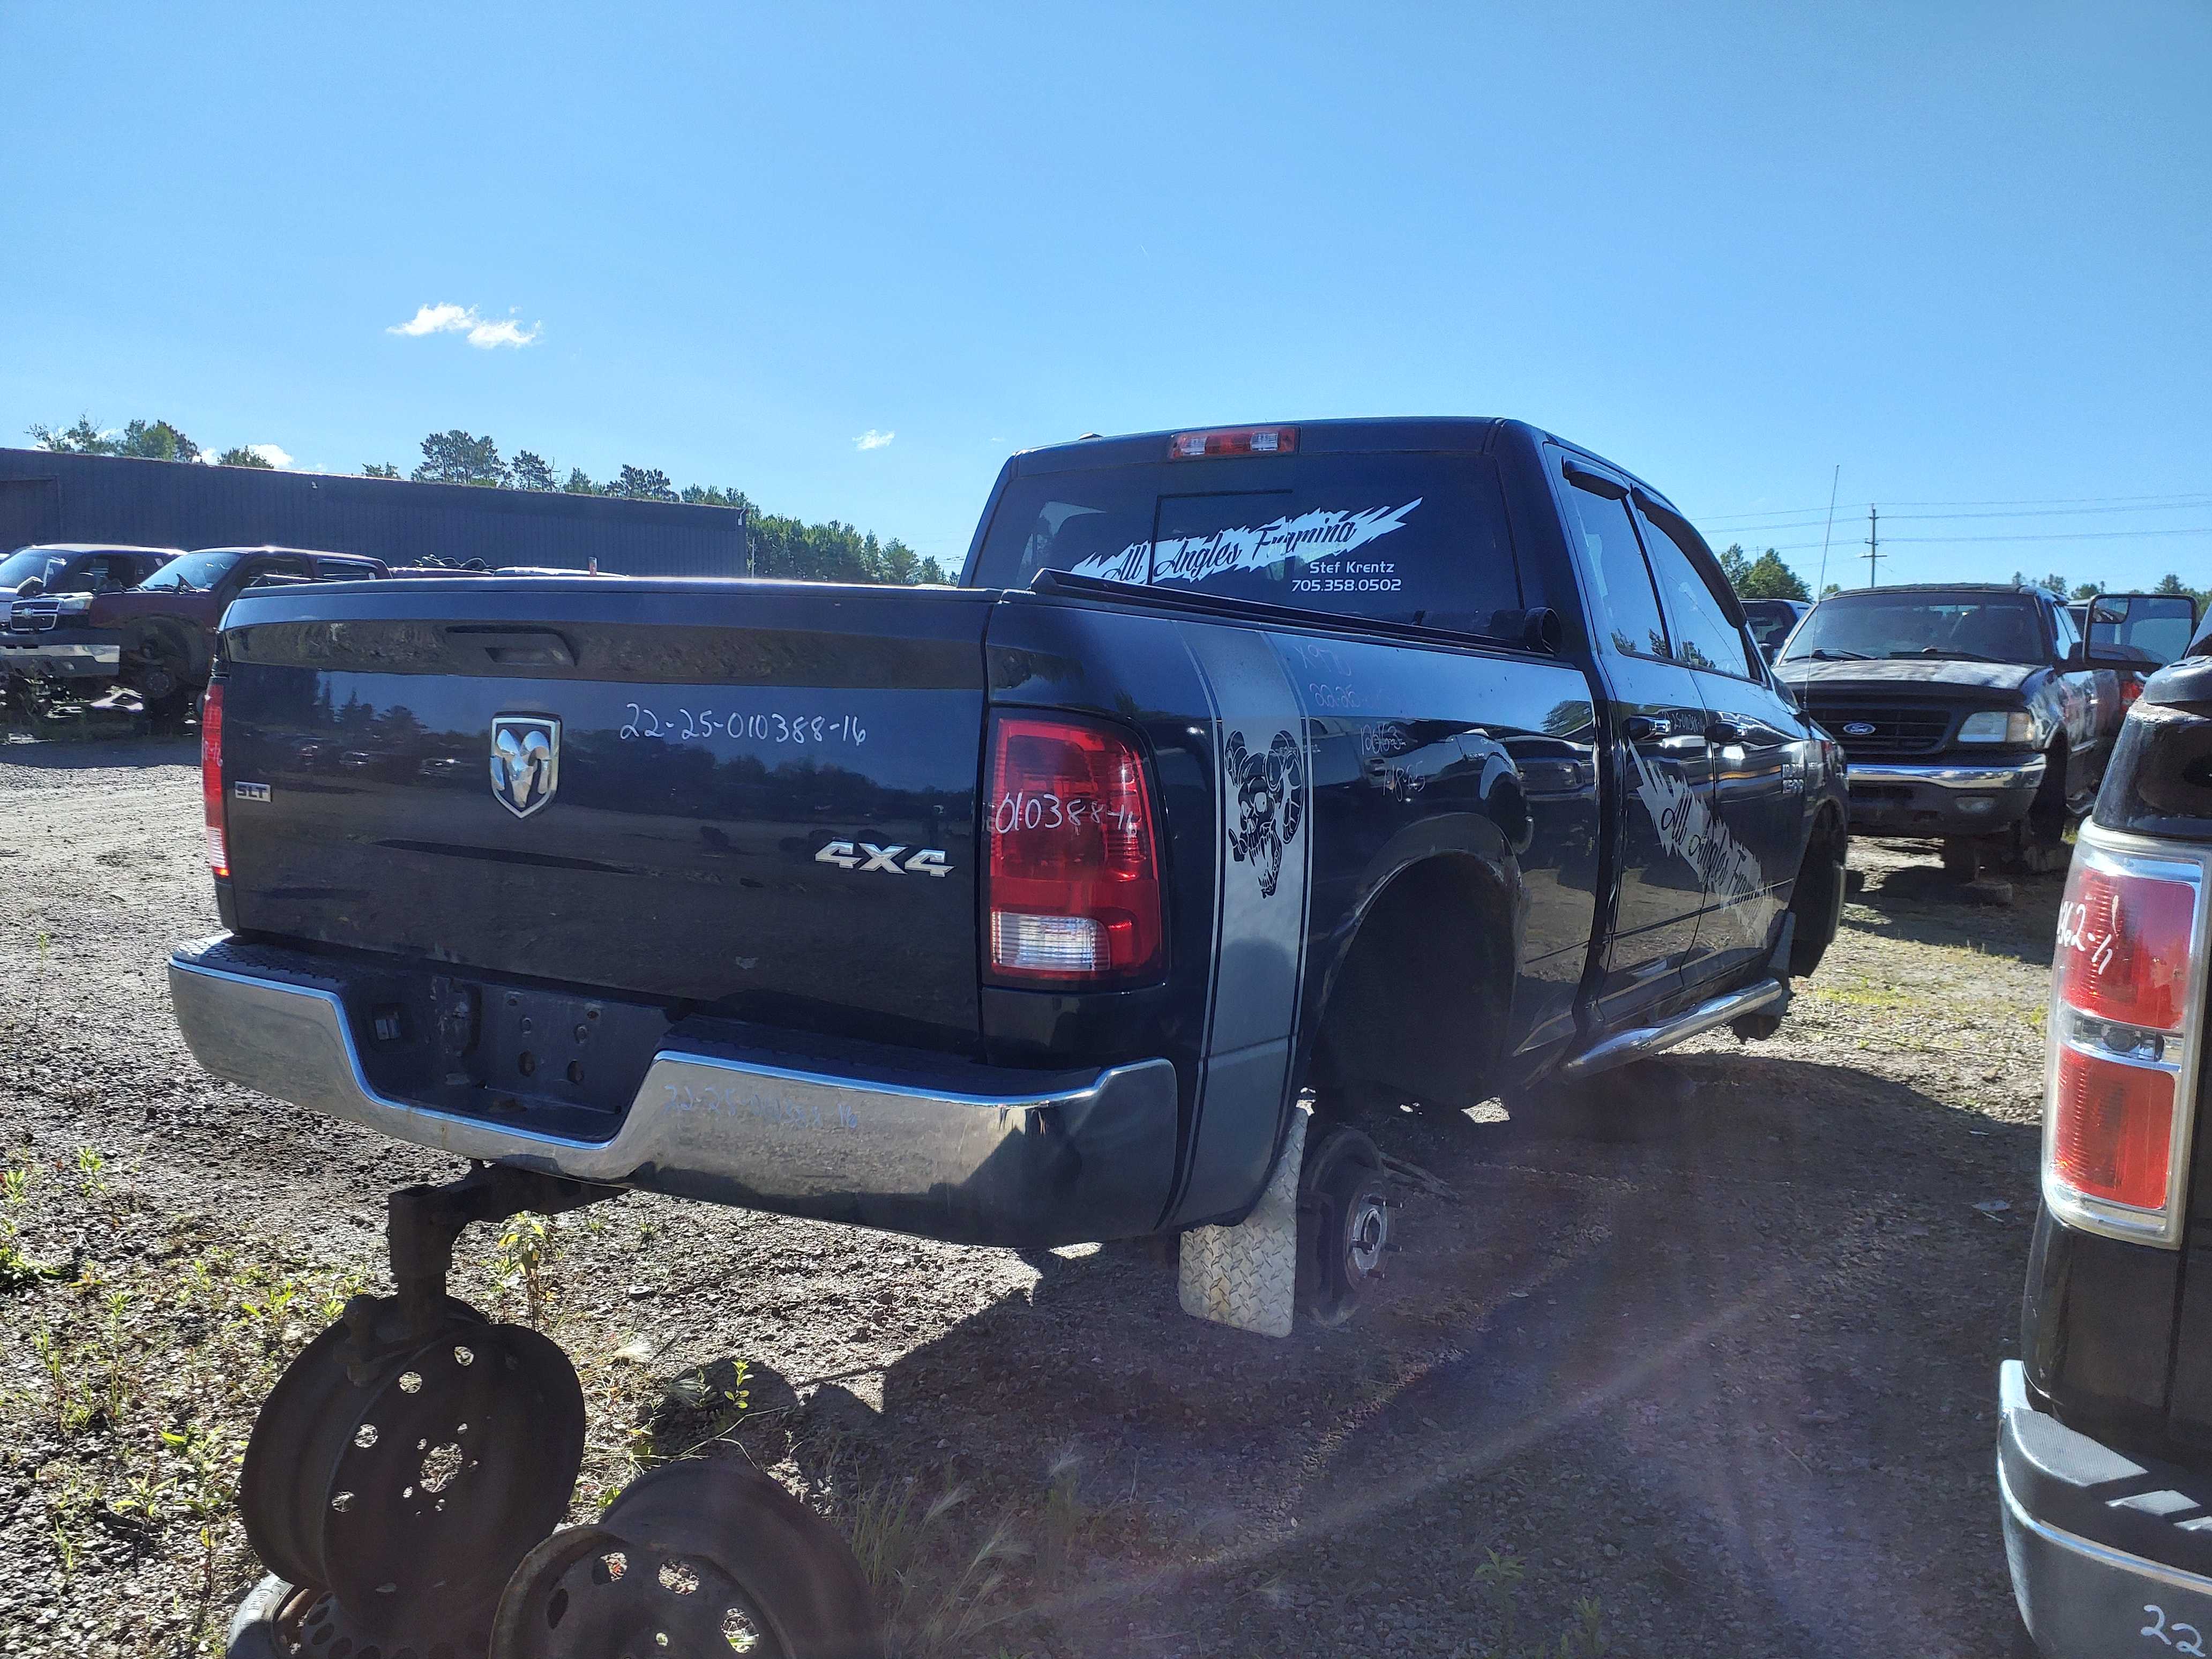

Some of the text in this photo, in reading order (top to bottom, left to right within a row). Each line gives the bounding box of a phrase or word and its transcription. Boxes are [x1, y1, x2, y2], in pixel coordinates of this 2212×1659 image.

[1101, 543, 1147, 580] All
[1153, 533, 1243, 578] Angles
[1310, 561, 1395, 574] Stef Krentz
[1291, 579, 1401, 592] 705.358.0502
[619, 703, 866, 746] 22-25-010388-16
[236, 784, 267, 799] SLT
[995, 792, 1138, 837] 010388-16
[1662, 794, 1692, 846] All
[2141, 1605, 2206, 1657] 22
